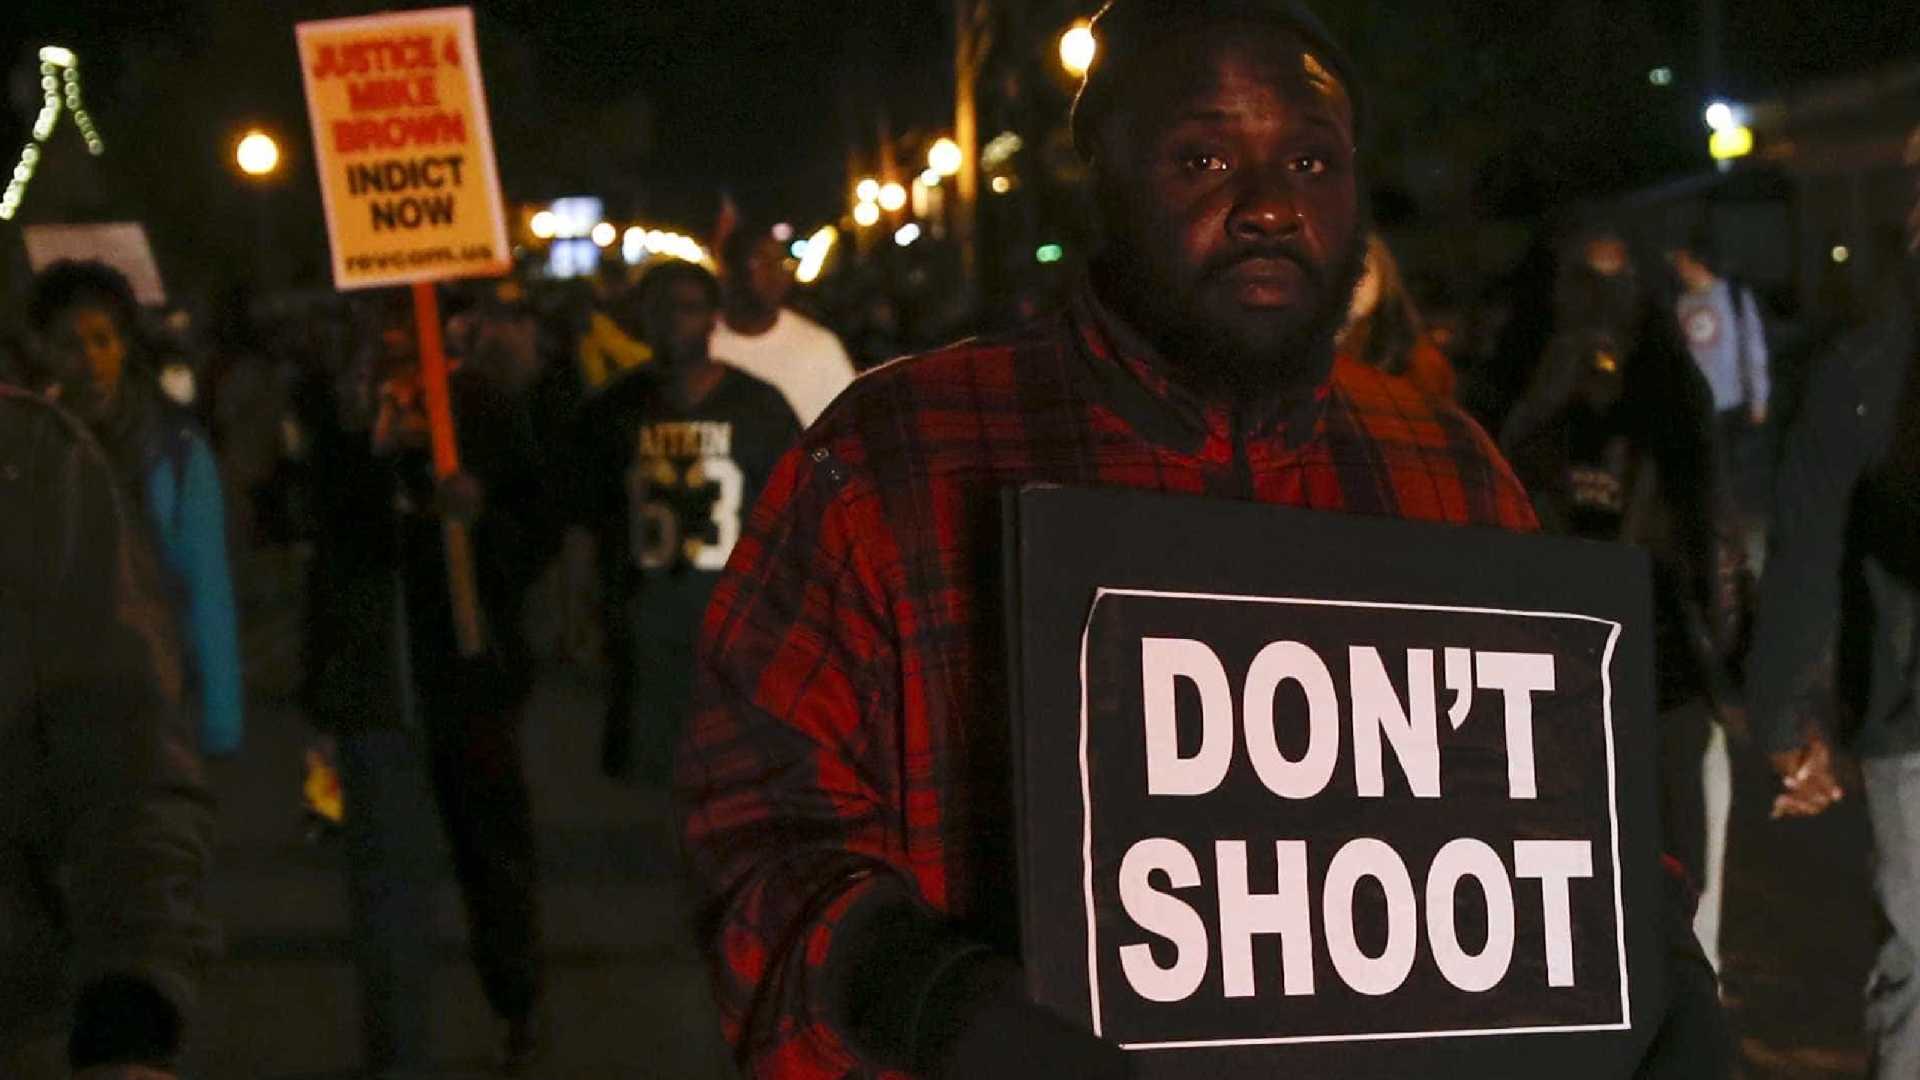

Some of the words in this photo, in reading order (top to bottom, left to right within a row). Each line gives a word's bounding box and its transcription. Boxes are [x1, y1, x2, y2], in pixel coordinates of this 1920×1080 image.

[314, 36, 438, 79] JUSTICE
[348, 76, 440, 111] MIKE
[334, 112, 466, 154] BROWN
[347, 156, 464, 195] INDICT
[371, 195, 454, 231] NOW
[346, 246, 492, 271] revcom.us
[1142, 637, 1555, 799] DON'T
[1118, 837, 1593, 1001] SHOOT
